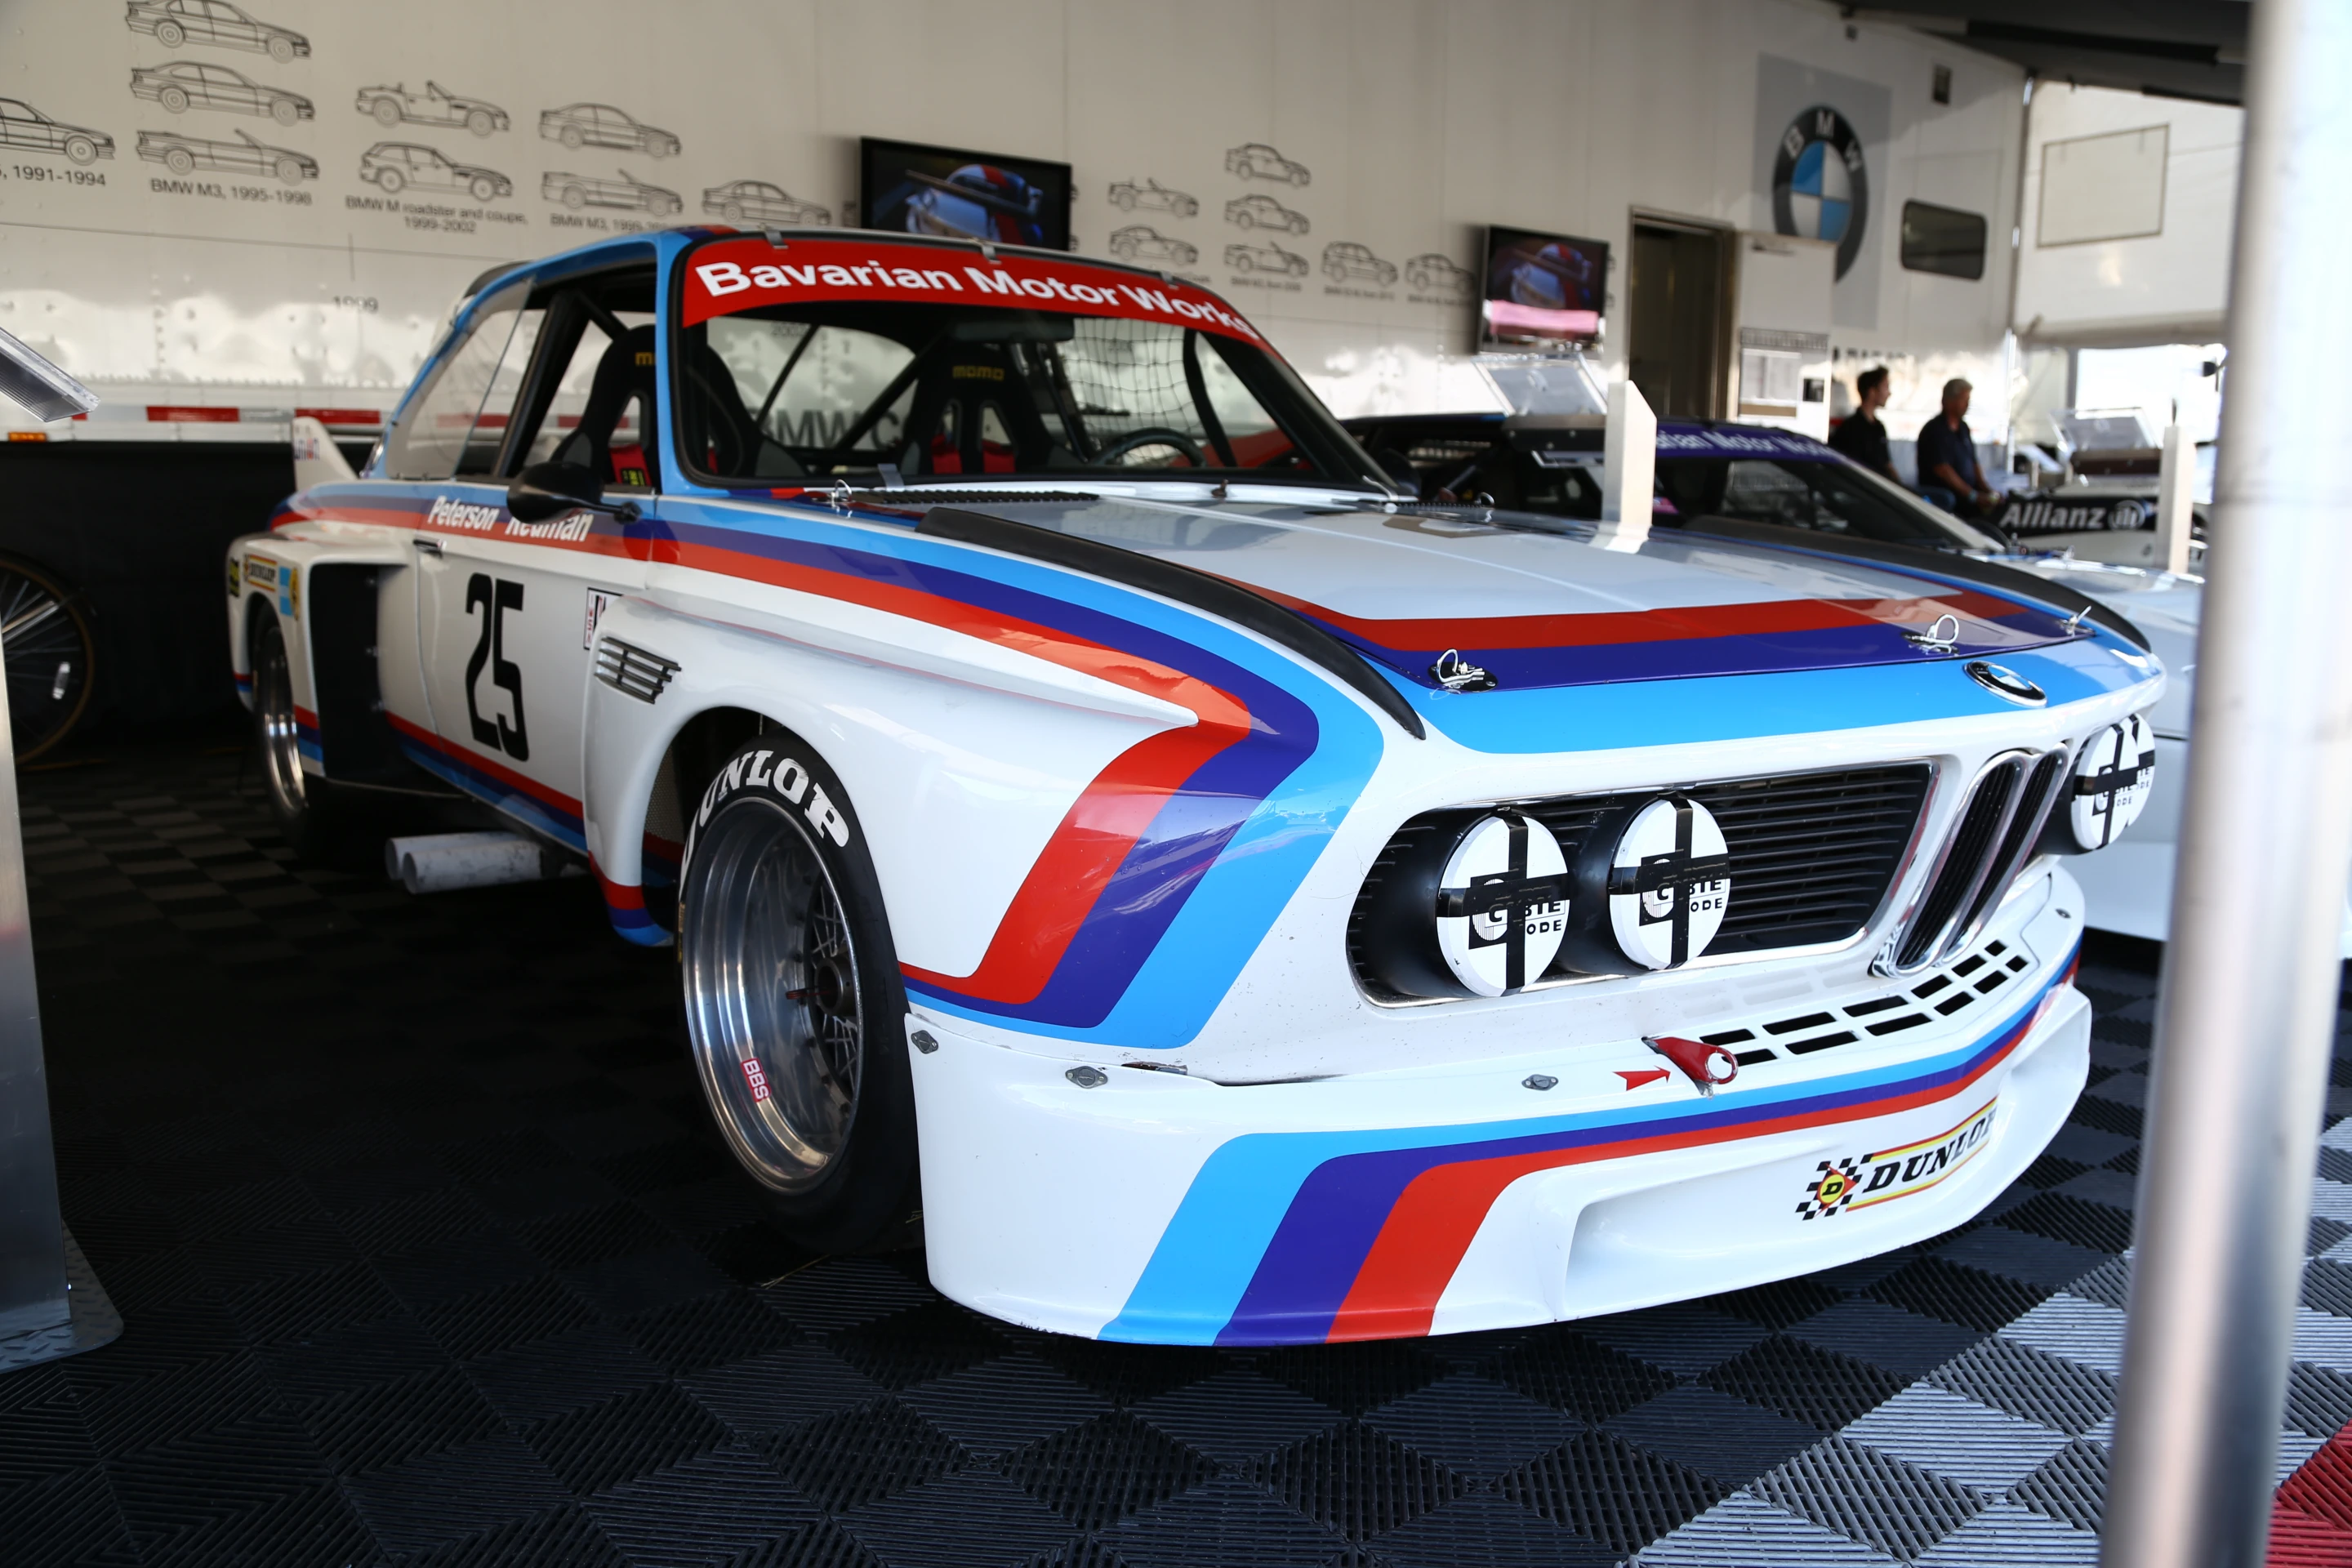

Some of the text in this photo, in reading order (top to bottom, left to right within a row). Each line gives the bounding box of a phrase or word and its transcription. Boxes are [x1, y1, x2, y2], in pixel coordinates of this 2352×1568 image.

[1784, 109, 1863, 172] BMW
[13, 165, 106, 186] 1991-1994
[150, 178, 194, 195] BMW
[345, 195, 384, 212] BMW
[386, 198, 400, 213] M
[403, 202, 456, 217] roadster
[459, 207, 483, 220] and
[696, 260, 1259, 341] Bavarian Motor Works
[427, 496, 500, 531] Peterson
[1998, 501, 2107, 529] Allianz
[466, 572, 529, 762] 25
[1690, 898, 1723, 913] ODE
[1526, 919, 1562, 935] ODE
[743, 1060, 769, 1099] BBS
[1821, 1181, 1844, 1197] D
